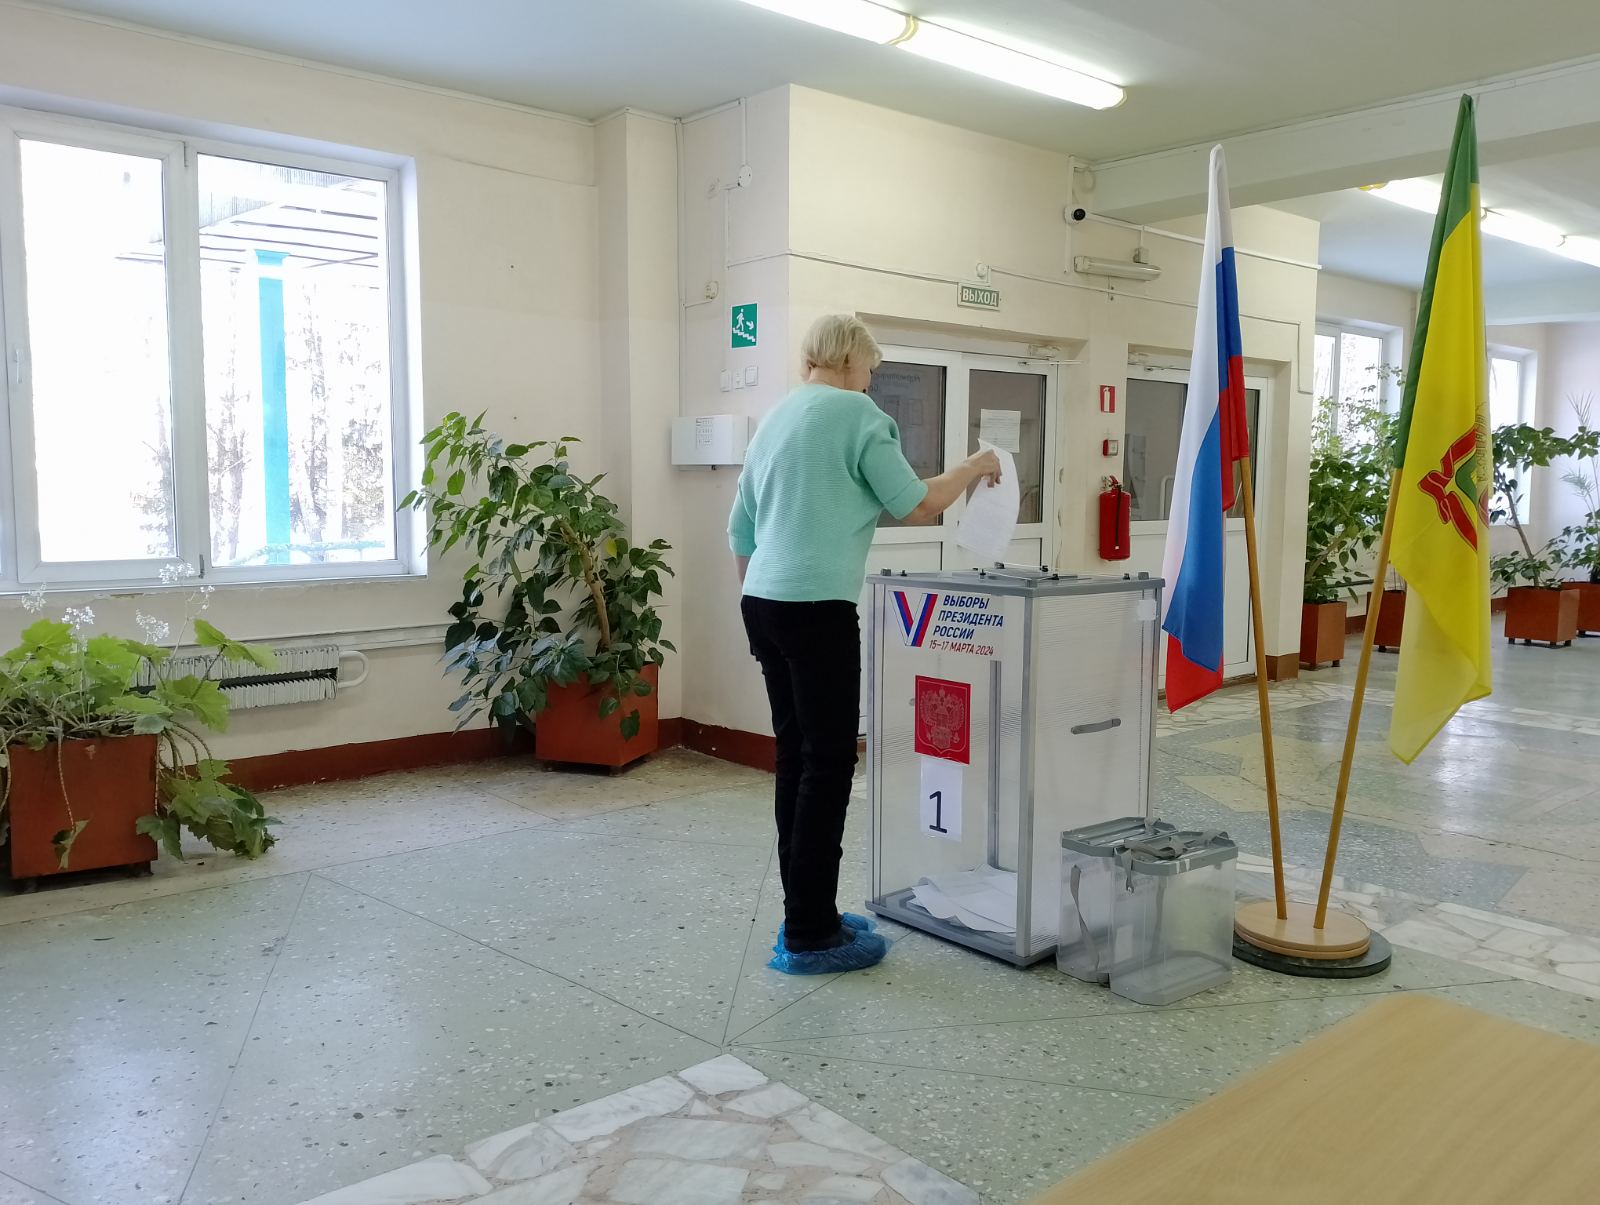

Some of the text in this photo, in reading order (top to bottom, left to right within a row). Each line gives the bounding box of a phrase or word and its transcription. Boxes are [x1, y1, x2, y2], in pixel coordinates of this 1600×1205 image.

[962, 288, 998, 306] ВЫХОД
[943, 595, 990, 609] ВЫБОРЫ
[938, 610, 1004, 627] ПРЕЗИДЕНТА
[933, 625, 975, 640] РОССИИ
[949, 641, 975, 654] МАРТА
[975, 645, 994, 656] 2024
[929, 790, 948, 834] 1
